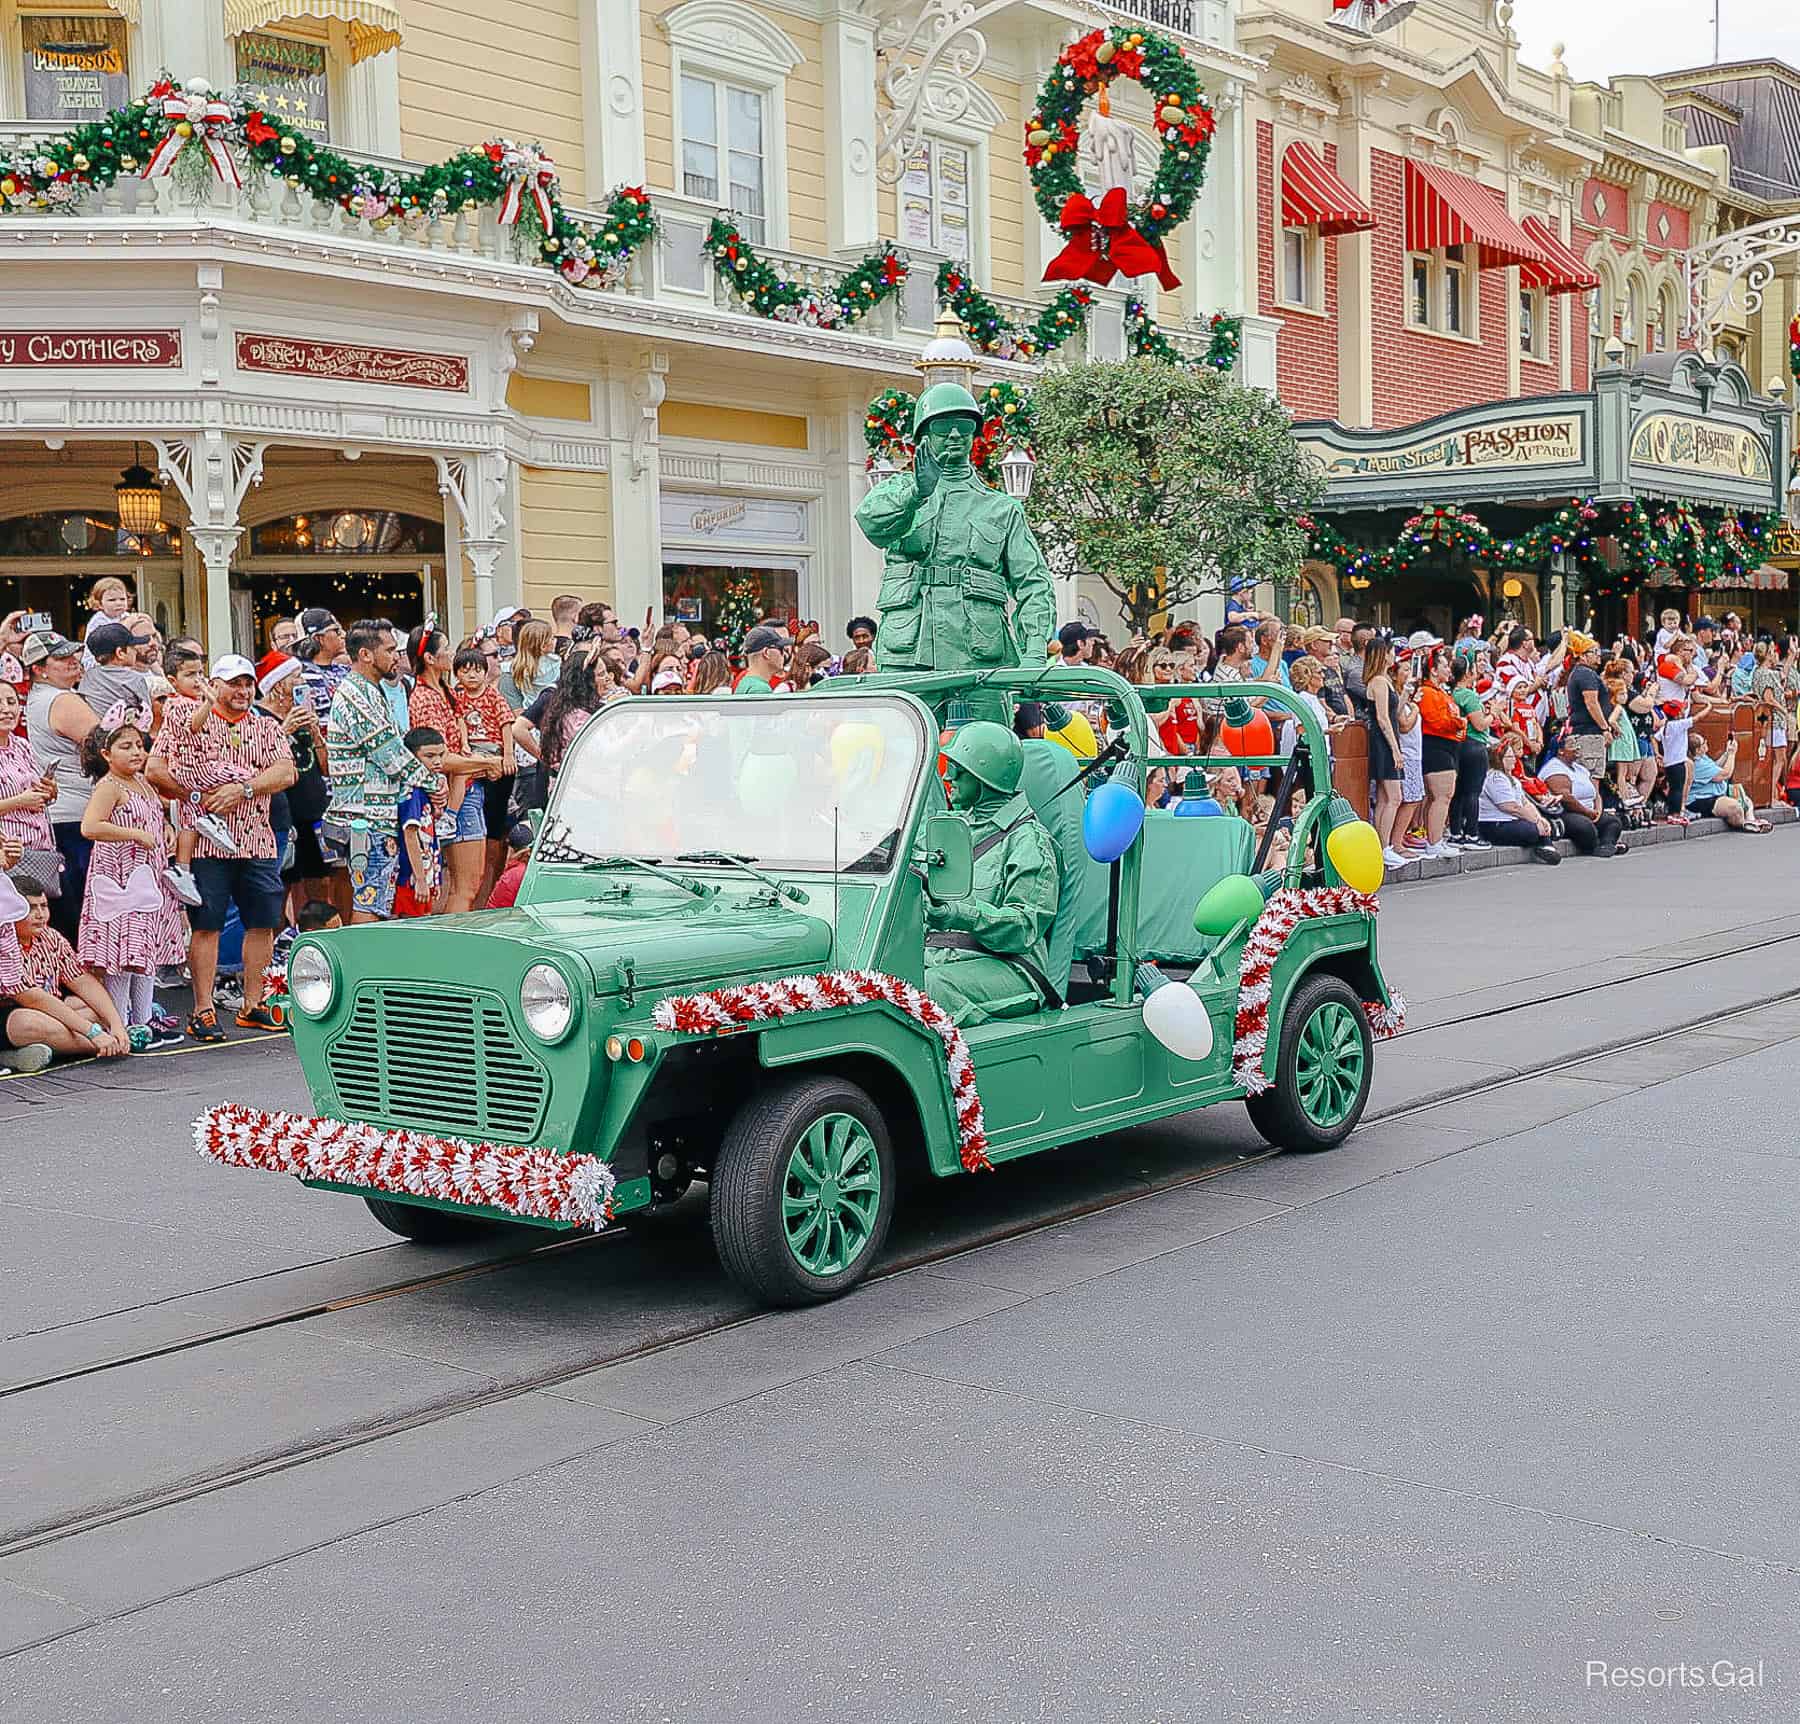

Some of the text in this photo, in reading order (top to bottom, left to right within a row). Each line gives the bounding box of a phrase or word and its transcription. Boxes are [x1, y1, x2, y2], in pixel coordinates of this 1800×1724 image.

[28, 335, 161, 362] CLOTHIERS
[1367, 442, 1445, 472] Main Street
[1458, 423, 1573, 466] FASHION
